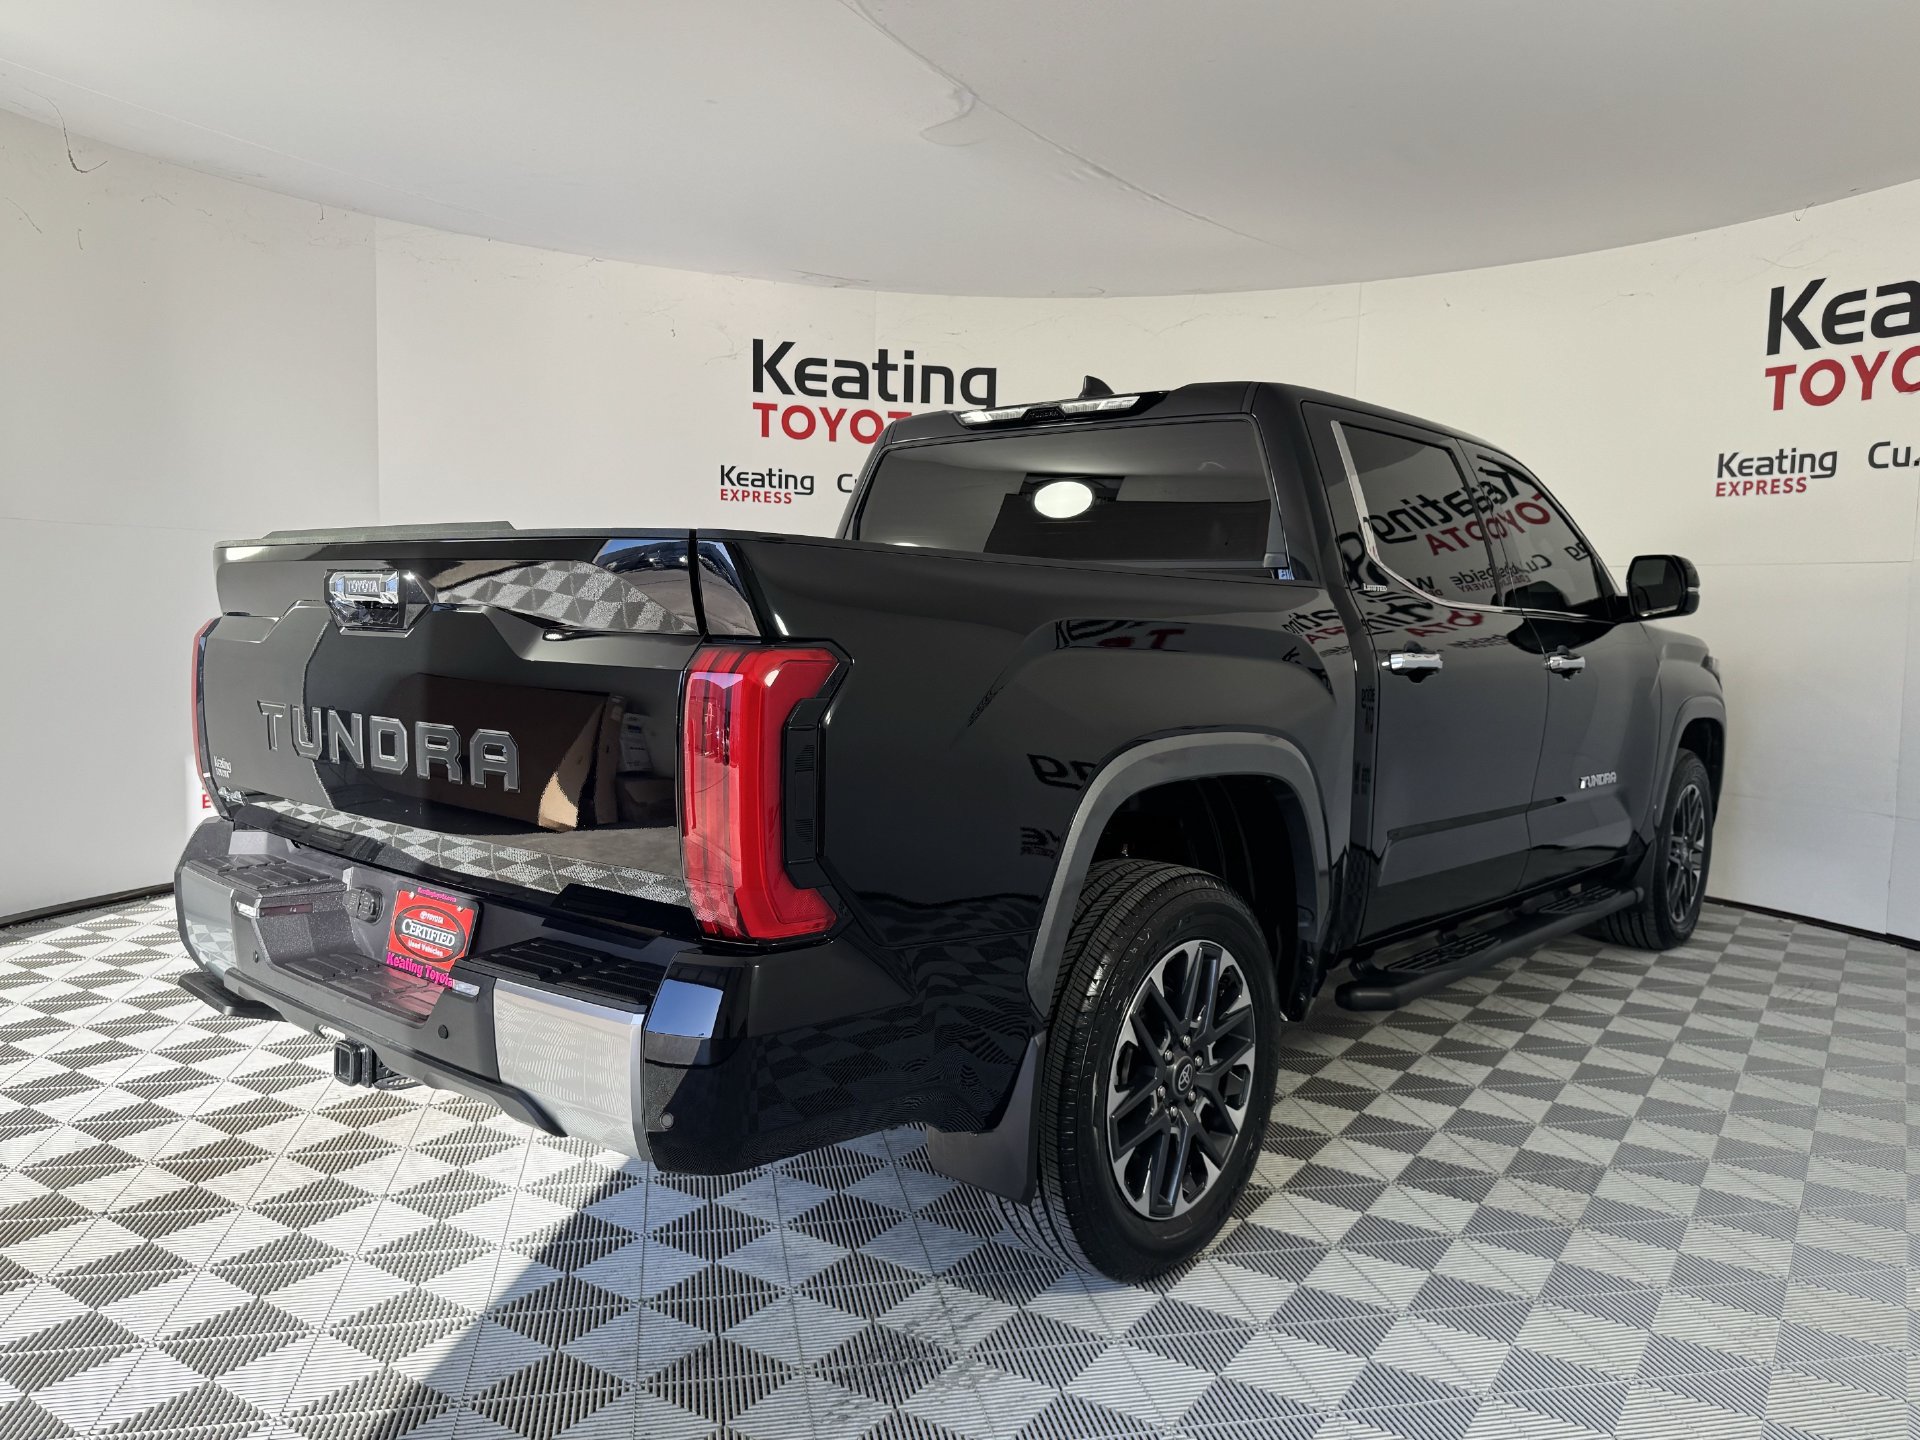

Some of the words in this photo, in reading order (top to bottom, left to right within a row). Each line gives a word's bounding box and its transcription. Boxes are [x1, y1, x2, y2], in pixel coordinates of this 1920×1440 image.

[752, 338, 997, 410] Keating
[1716, 448, 1838, 480] Keating
[719, 464, 815, 496] Keating
[1714, 476, 1808, 498] EXPRESS
[719, 488, 793, 505] EXPRESS
[346, 579, 379, 593] TOYOTA
[256, 700, 521, 793] TUNDRA
[1580, 771, 1617, 789] TUNDRA
[401, 918, 456, 947] CERTIFIED
[408, 940, 421, 950] Used
[422, 945, 444, 957] Vehicles
[386, 952, 424, 978] Keating
[425, 964, 455, 989] Toyota
